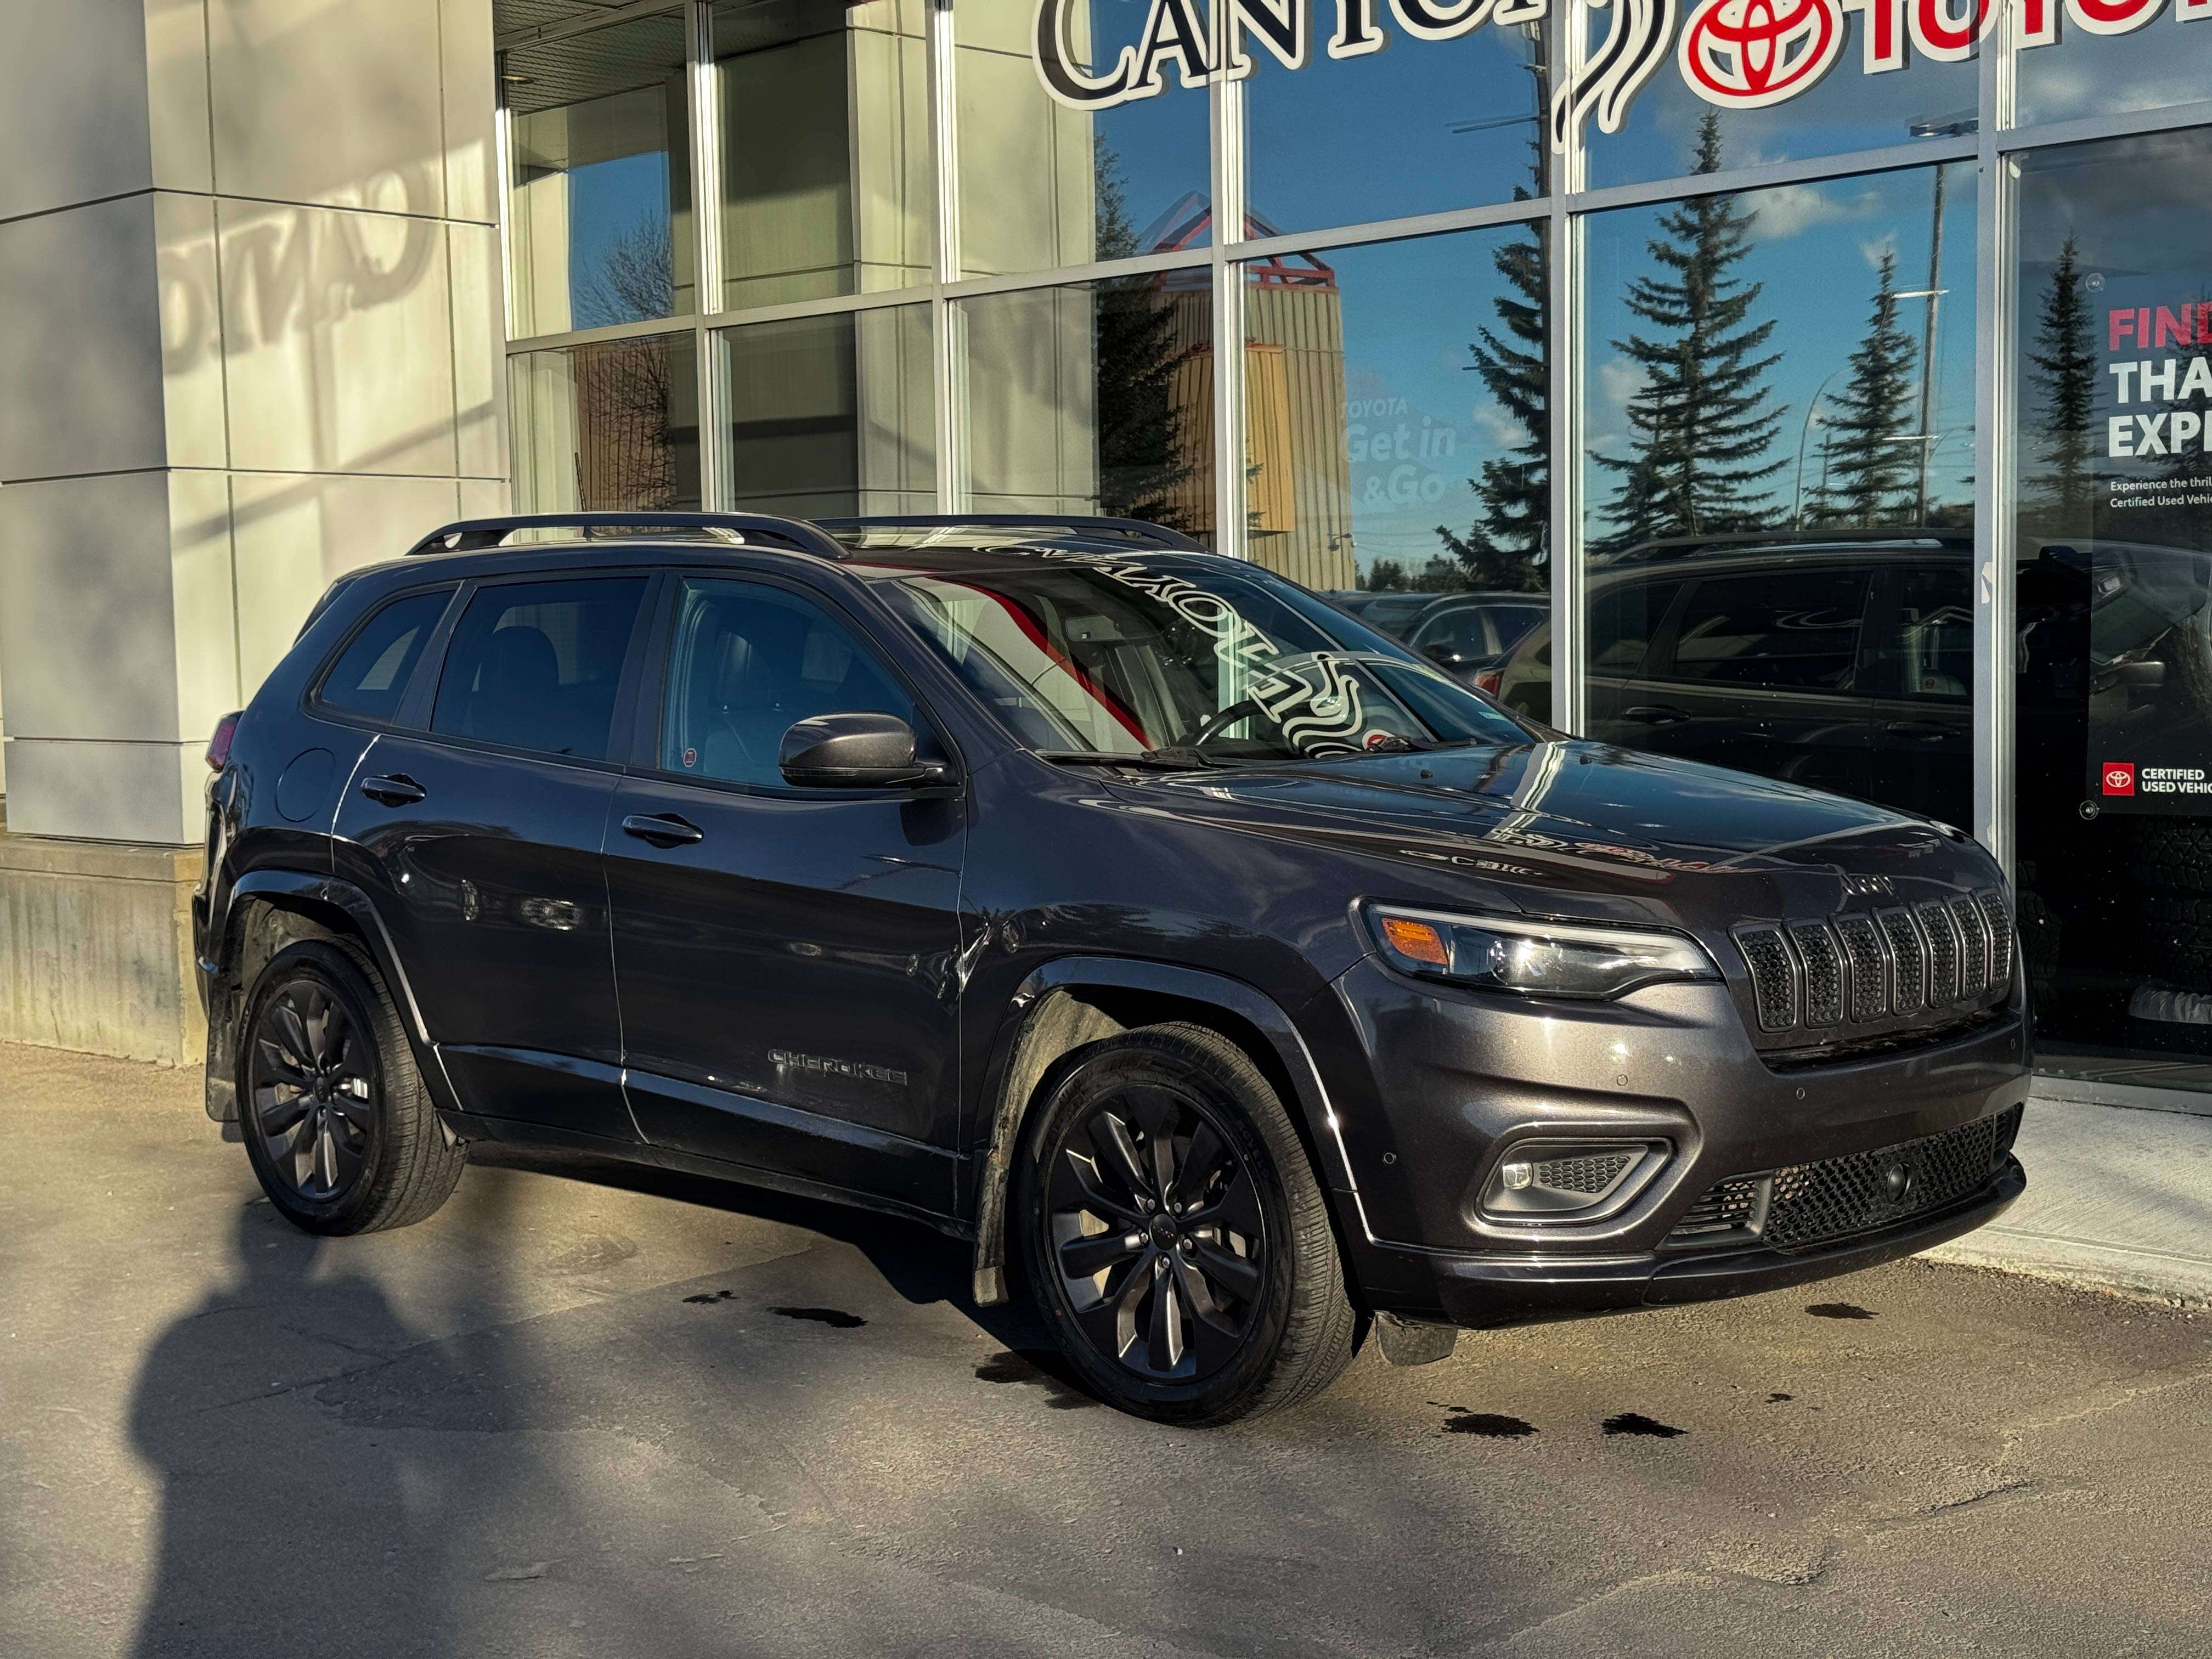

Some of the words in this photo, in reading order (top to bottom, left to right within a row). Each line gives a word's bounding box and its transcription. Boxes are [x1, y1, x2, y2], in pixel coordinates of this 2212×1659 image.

[1031, 0, 1612, 111] CAN
[2109, 357, 2212, 404] THA
[1341, 396, 1408, 419] TOYOTA
[1340, 423, 1412, 463] Get
[1419, 414, 1456, 458] in
[2108, 410, 2212, 458] EXP
[2110, 480, 2167, 493] Experience
[2170, 477, 2187, 488] the
[2110, 495, 2155, 508] Certified
[2157, 494, 2184, 506] Used
[2141, 768, 2205, 781] CERTIFIED
[2141, 781, 2176, 793] USED
[2176, 782, 2212, 794] VEHIC
